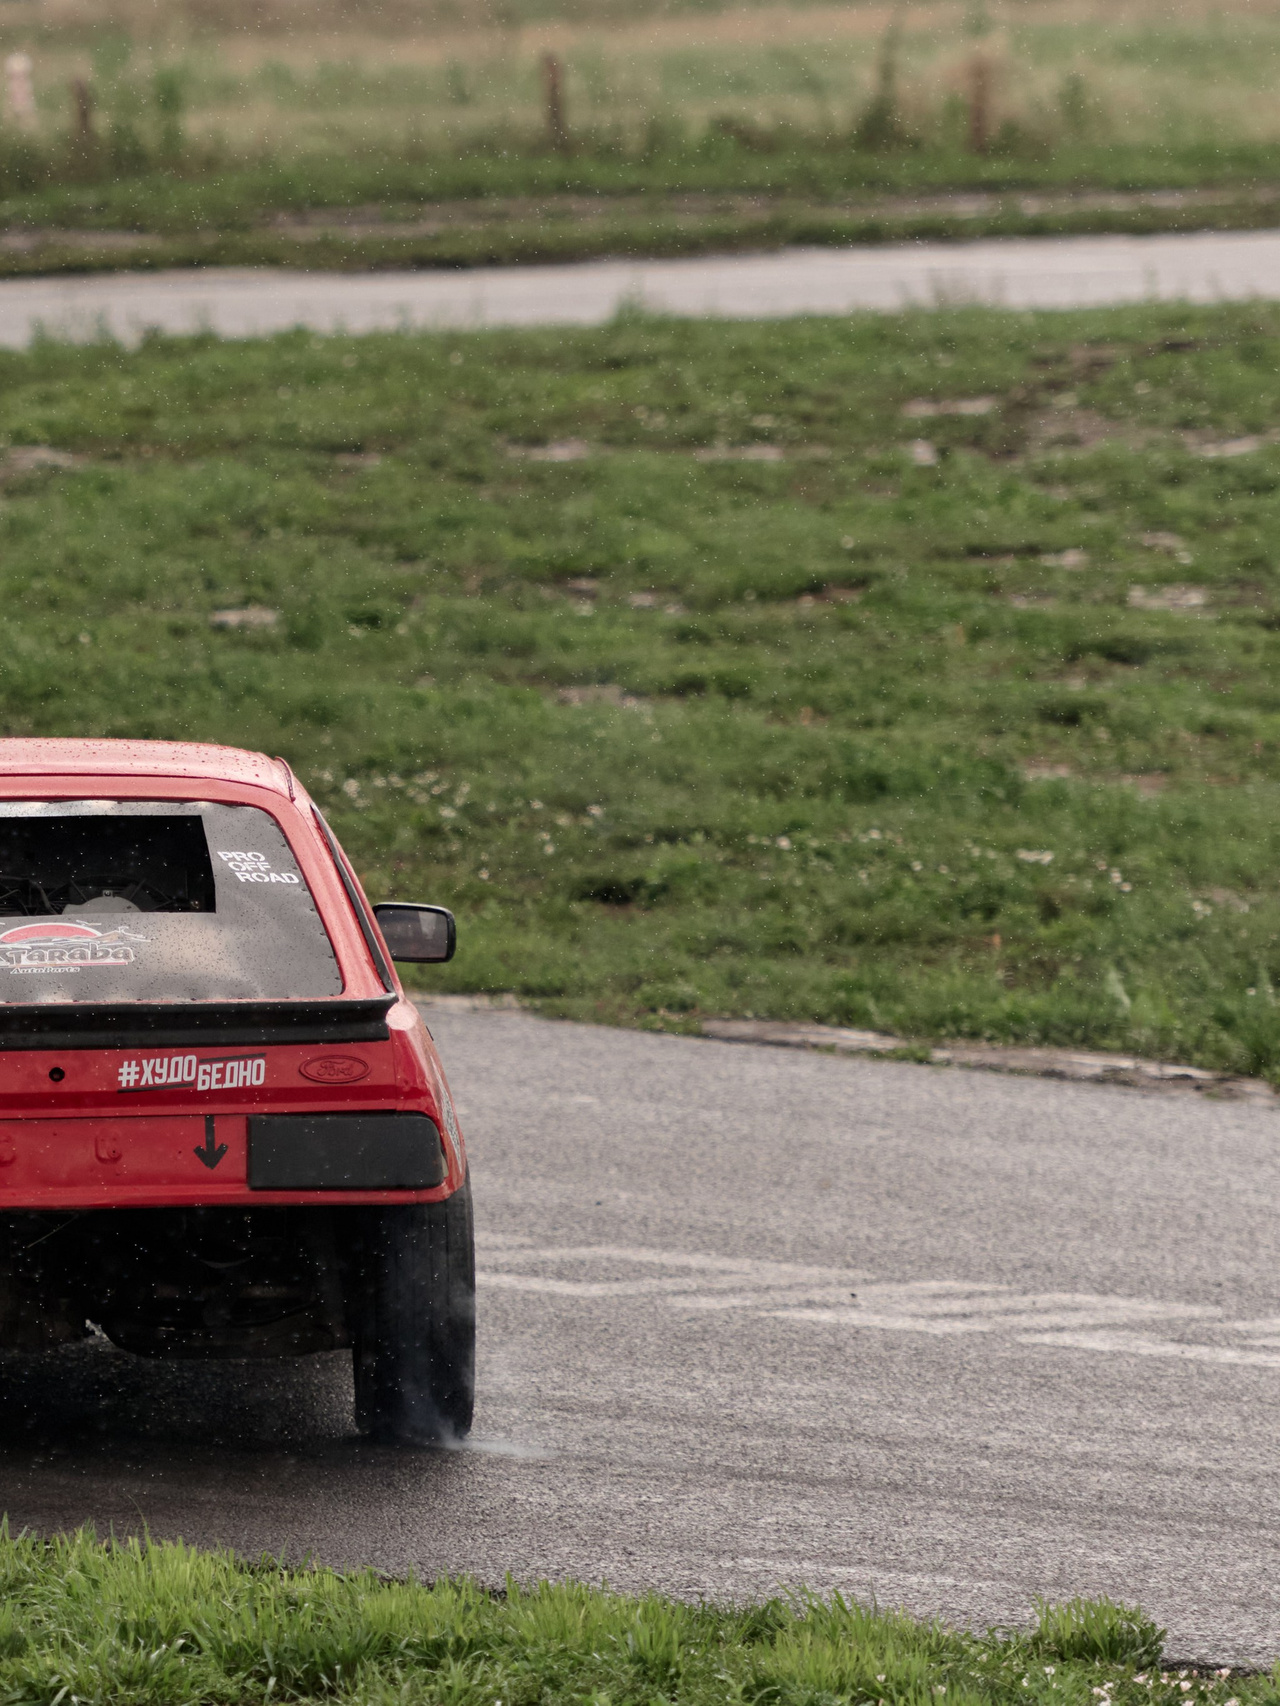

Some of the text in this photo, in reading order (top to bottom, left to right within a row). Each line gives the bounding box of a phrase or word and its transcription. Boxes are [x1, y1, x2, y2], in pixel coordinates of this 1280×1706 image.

[217, 851, 265, 862] PRO
[228, 861, 271, 872] OFF
[235, 872, 299, 884] ROAD
[317, 1061, 354, 1077] Ford
